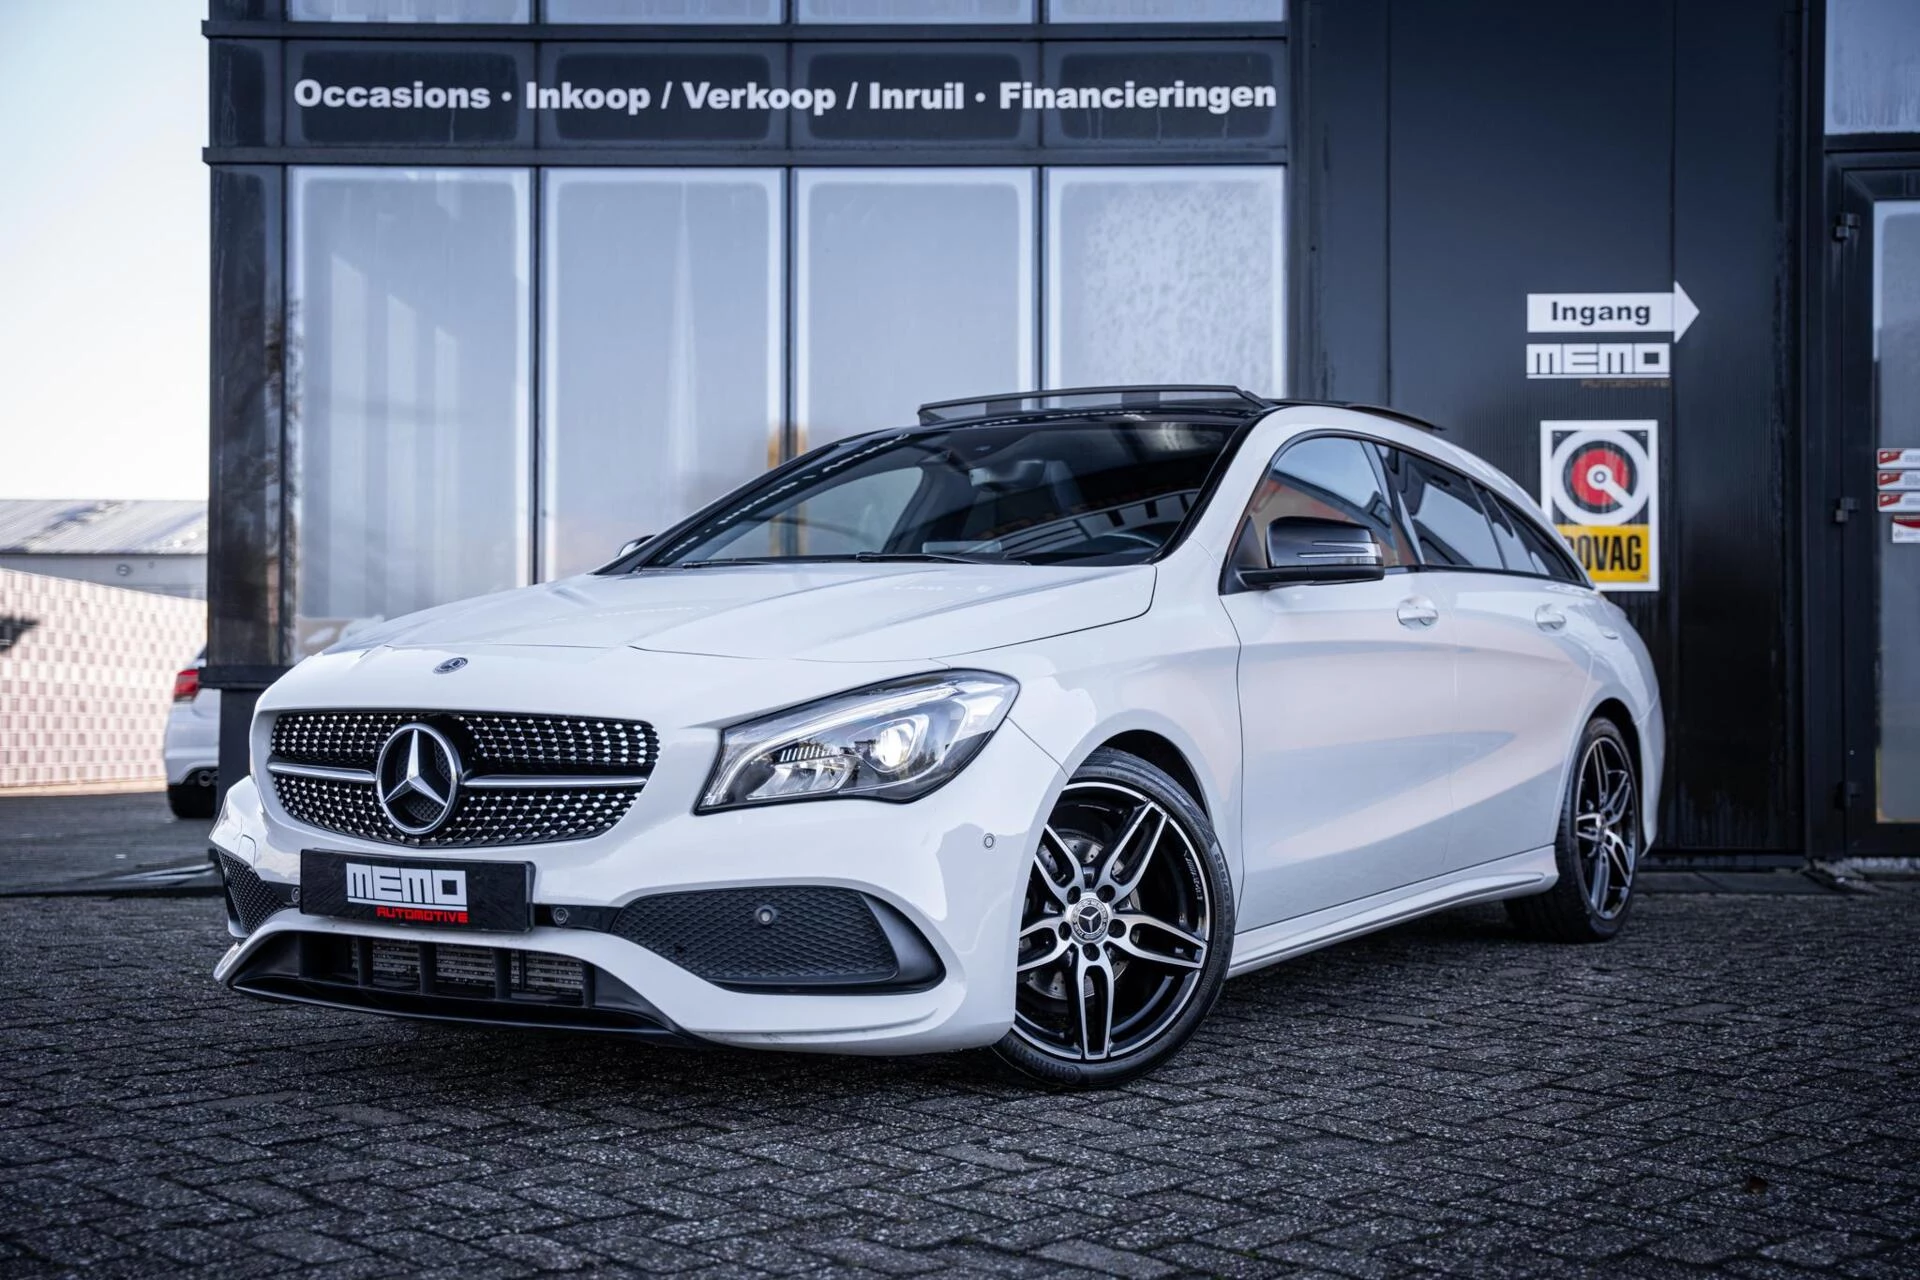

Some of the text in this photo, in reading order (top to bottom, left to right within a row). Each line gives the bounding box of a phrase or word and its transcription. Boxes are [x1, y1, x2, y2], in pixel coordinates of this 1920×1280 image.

[294, 79, 491, 109] Occasions
[526, 81, 651, 116] Inkoop
[682, 81, 837, 116] Verkoop
[869, 81, 965, 110] Inruil
[999, 80, 1277, 115] Financieringen
[1552, 301, 1651, 326] Ingang
[1527, 343, 1670, 376] MEMO
[345, 862, 468, 908] MEMO
[376, 906, 469, 924] AUTOMOTIVE
